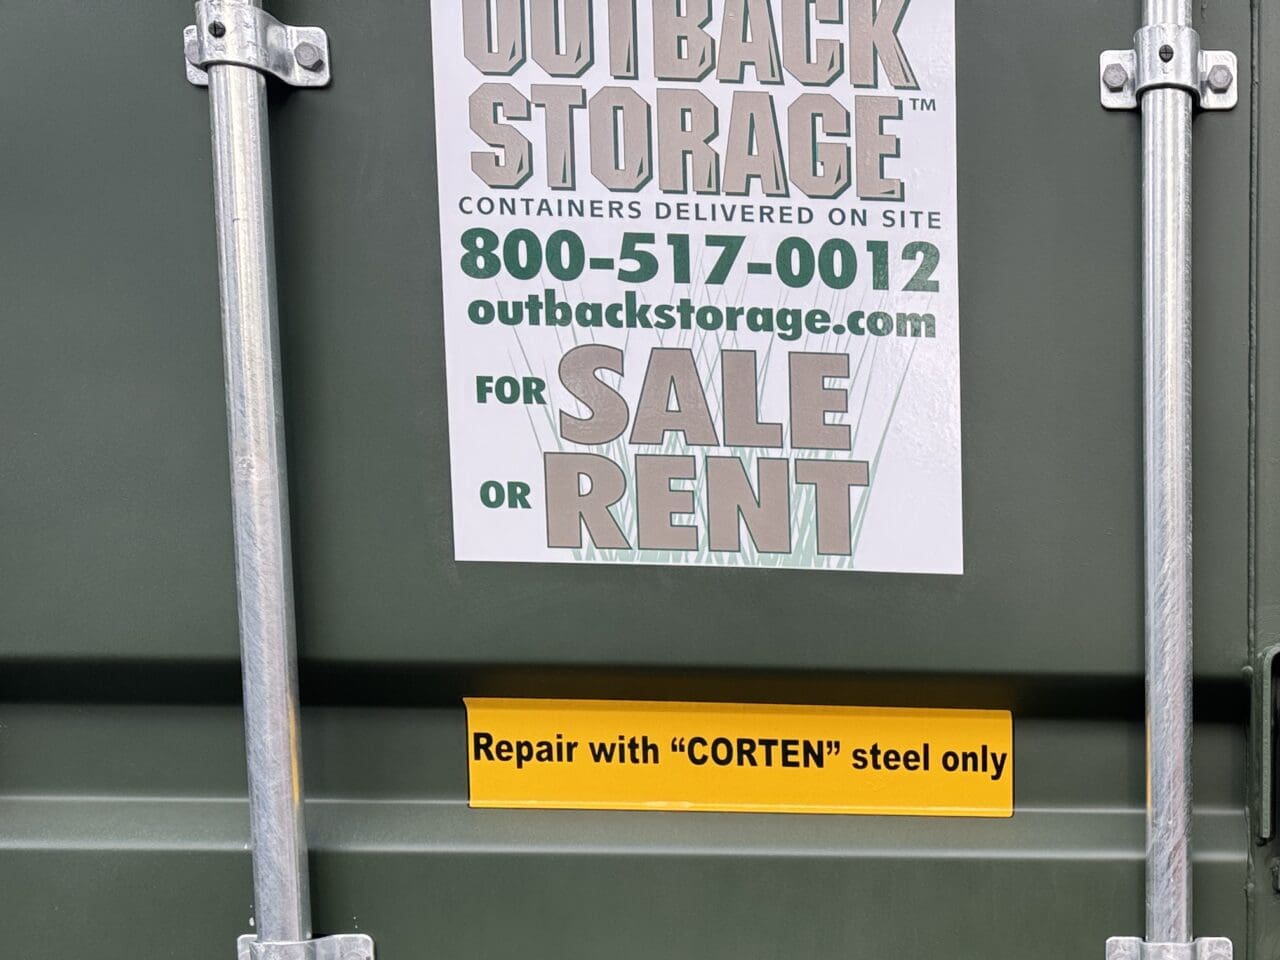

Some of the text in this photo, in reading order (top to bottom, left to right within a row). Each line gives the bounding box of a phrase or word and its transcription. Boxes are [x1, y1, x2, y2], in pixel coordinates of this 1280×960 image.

[463, 0, 920, 90] OUTBACK
[468, 82, 905, 201] STORAGE
[458, 196, 942, 229] CONTAINERS DELIVERED ON SITE
[460, 227, 940, 292] 800-517-0012
[467, 289, 937, 341] outbackstorage.com
[475, 343, 852, 451] FOR SALE
[479, 451, 870, 556] OR RENT
[472, 732, 578, 769] Repair
[588, 736, 660, 765] with
[851, 743, 930, 772] steel
[942, 746, 1008, 781] only
